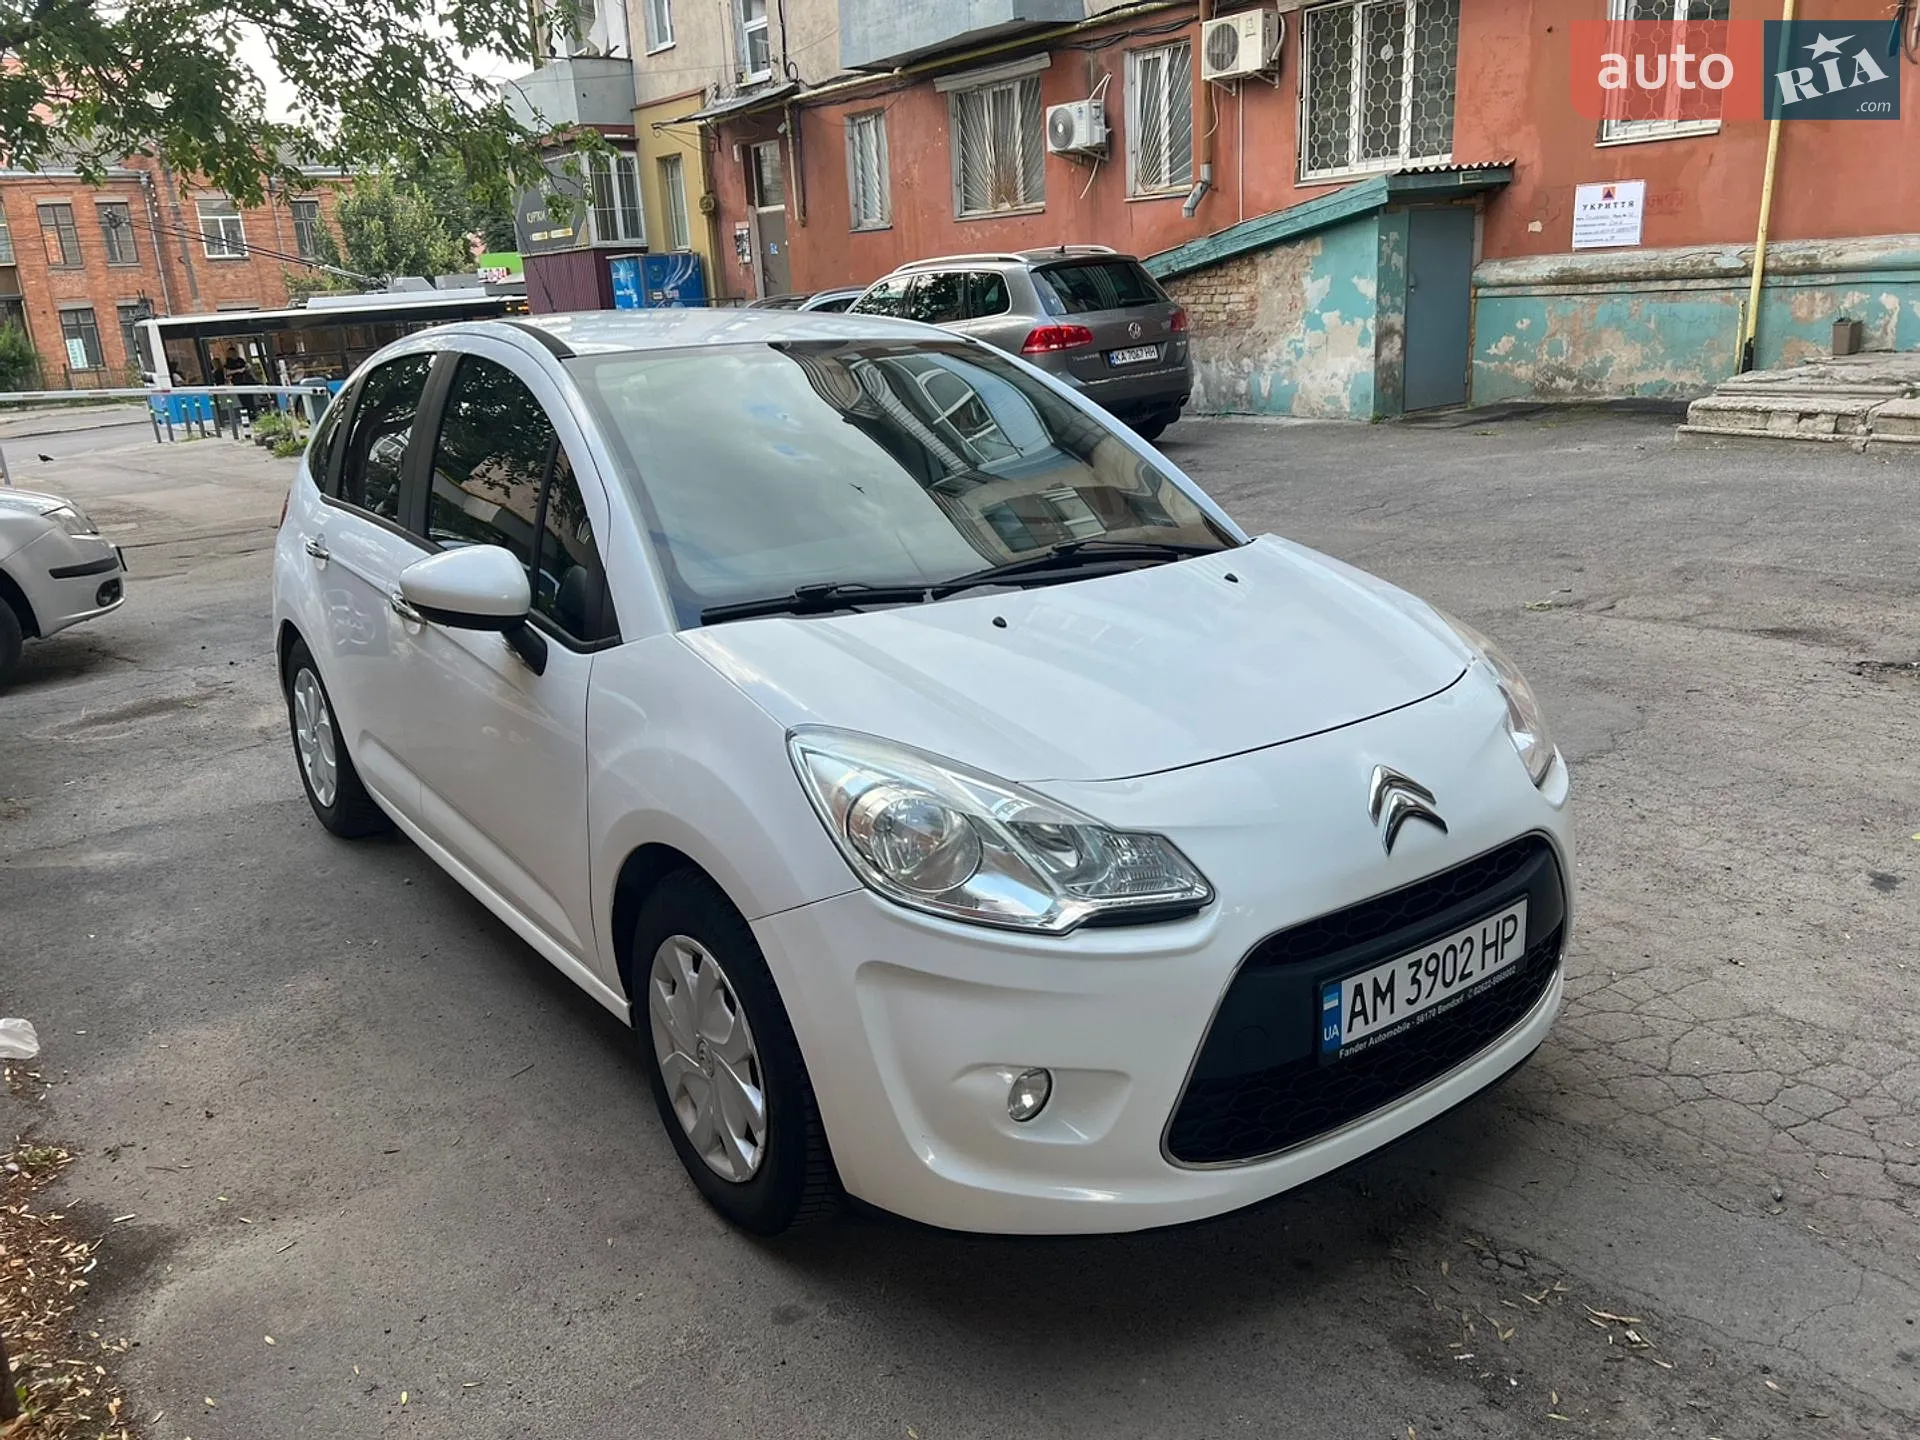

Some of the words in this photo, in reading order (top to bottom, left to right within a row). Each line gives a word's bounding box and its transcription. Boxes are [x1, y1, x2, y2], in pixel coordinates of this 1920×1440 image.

[1583, 200, 1634, 210] УКРИТТЯ
[1346, 969, 1396, 1034] AM
[1405, 936, 1475, 1006] 3902
[1481, 913, 1519, 971] HP
[1323, 1024, 1339, 1041] UA
[1339, 1041, 1367, 1059] Fander
[1368, 1021, 1411, 1047] Automobile
